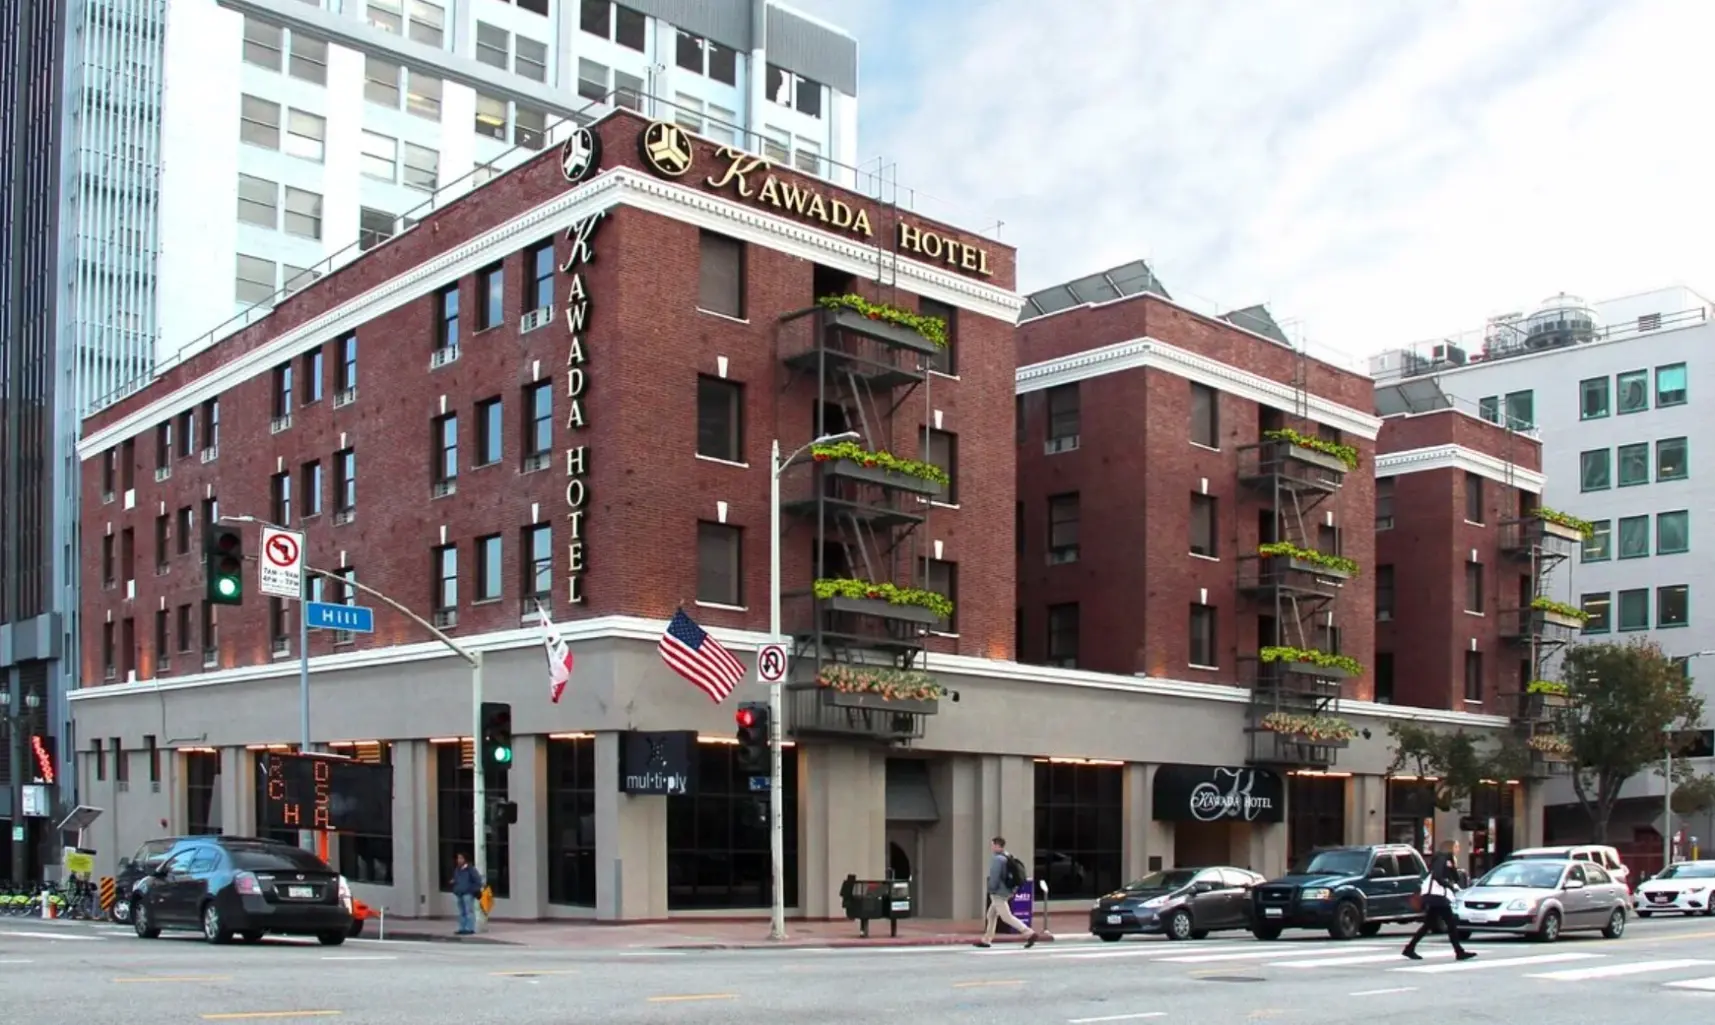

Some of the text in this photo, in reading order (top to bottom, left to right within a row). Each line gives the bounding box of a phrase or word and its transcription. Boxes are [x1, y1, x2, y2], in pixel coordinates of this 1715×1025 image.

[707, 146, 993, 276] KAWADA HOTEL
[559, 210, 604, 603] KAWADA HOTEL
[322, 609, 357, 625] Hill
[1244, 796, 1273, 809] HOTEL
